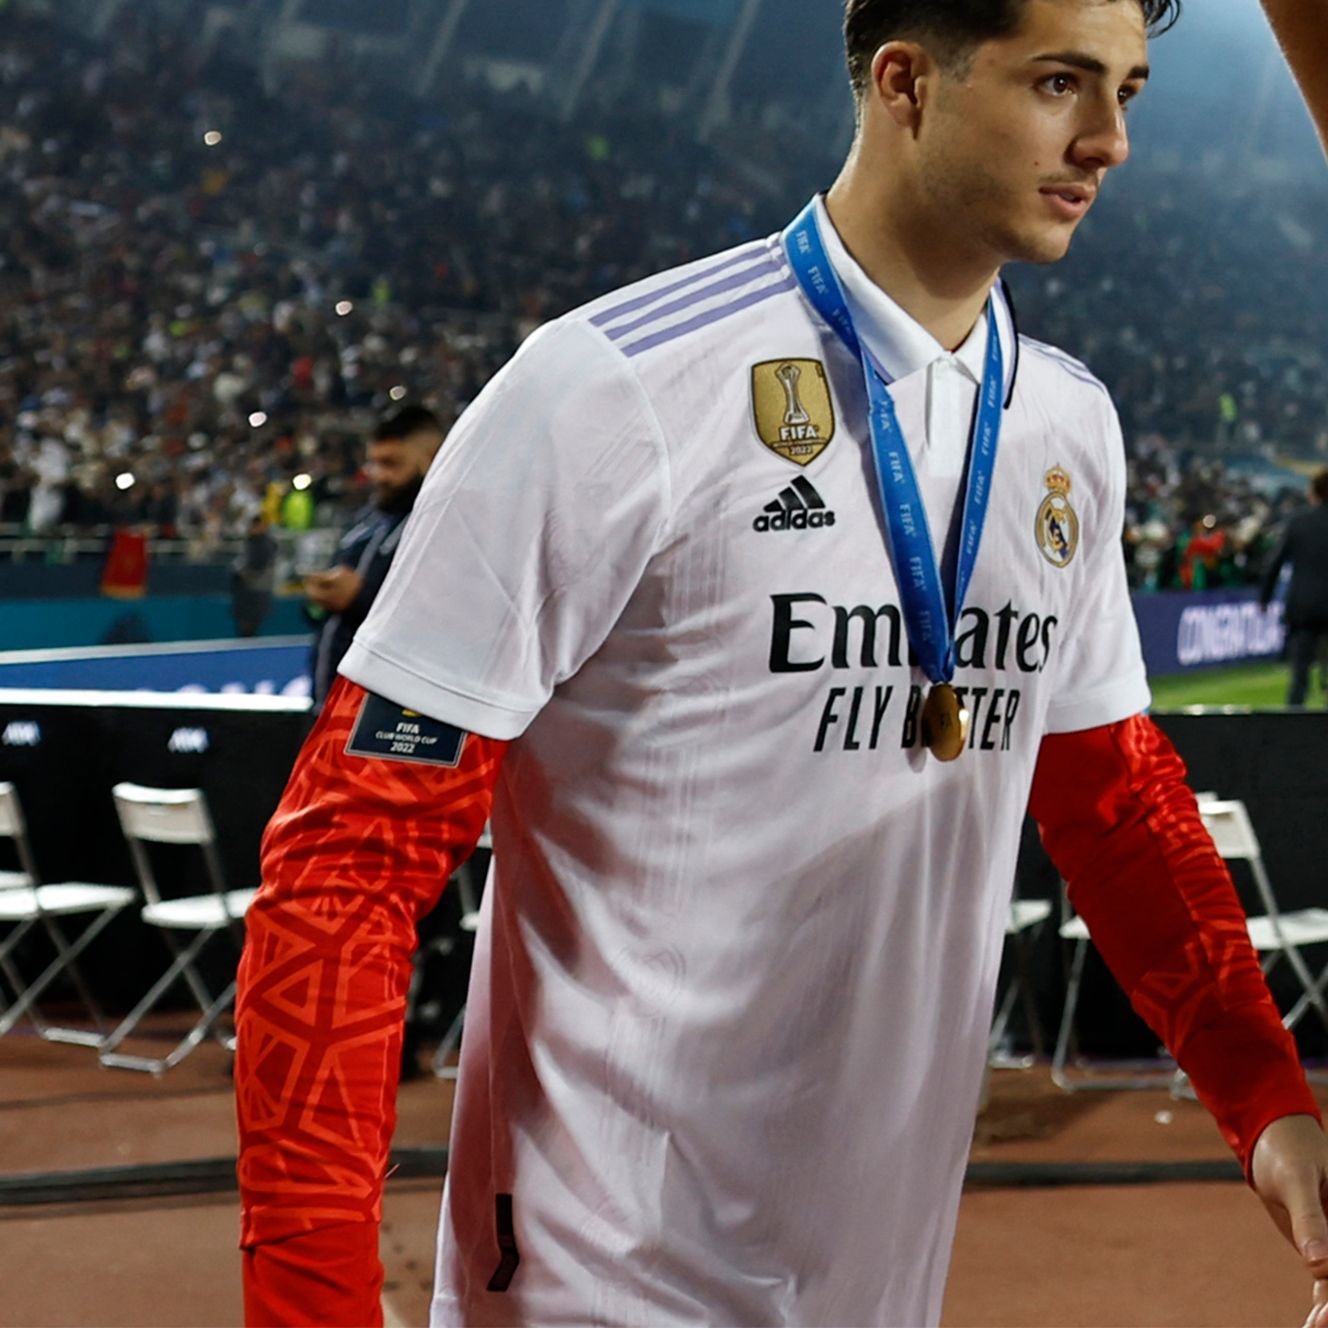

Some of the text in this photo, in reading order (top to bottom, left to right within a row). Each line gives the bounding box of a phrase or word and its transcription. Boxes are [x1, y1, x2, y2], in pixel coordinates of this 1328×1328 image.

[808, 266, 829, 295] FIFA
[780, 425, 818, 441] FIFA
[889, 451, 904, 483] FIFA
[753, 510, 836, 533] adidas
[900, 503, 914, 536] FIFA
[910, 556, 926, 591] FIFA
[768, 591, 1060, 675] Emates
[396, 723, 420, 734] FIFA
[812, 684, 894, 753] FLY
[390, 741, 416, 753] 2022
[395, 734, 421, 743] WORLD
[420, 735, 439, 745] CUP
